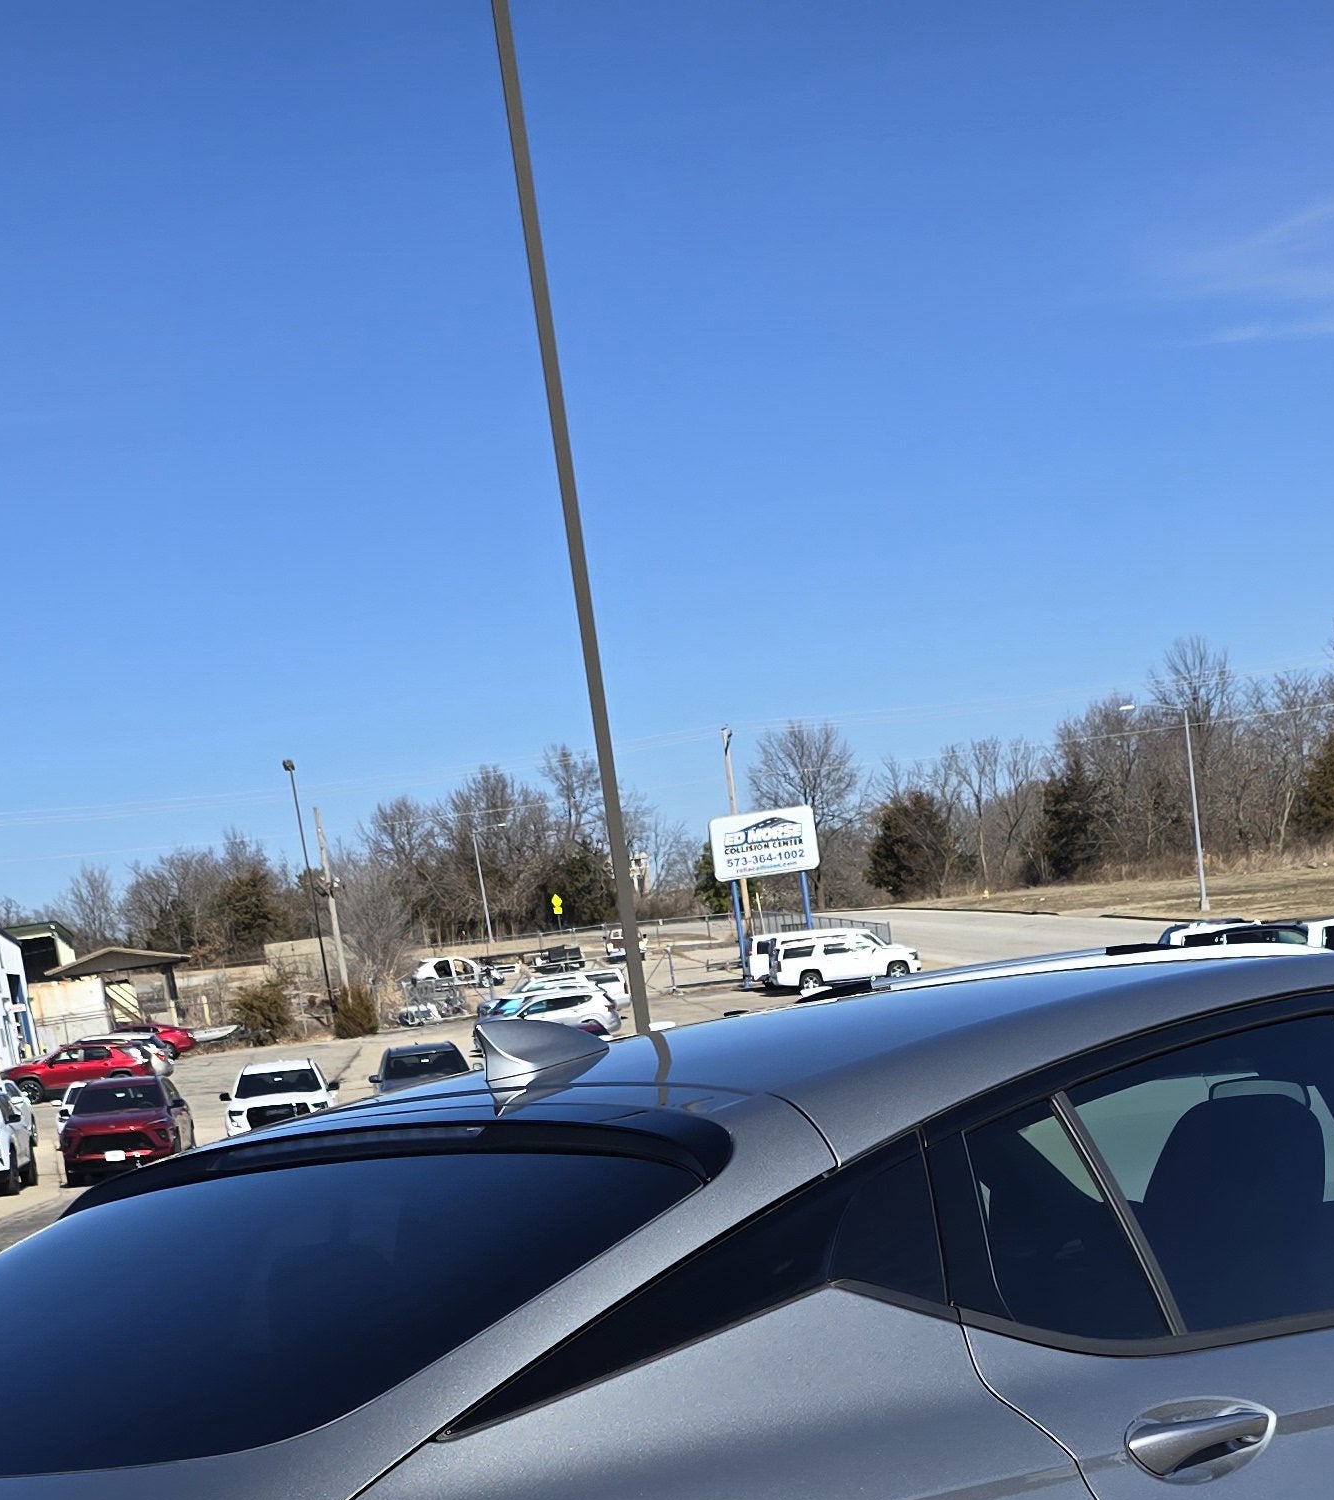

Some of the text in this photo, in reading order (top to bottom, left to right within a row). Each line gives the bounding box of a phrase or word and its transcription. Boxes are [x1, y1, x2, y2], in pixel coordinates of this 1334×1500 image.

[725, 822, 803, 847] ED MORSE
[724, 838, 804, 855] COLLISION CENTER
[727, 849, 806, 868] 573-364-1002
